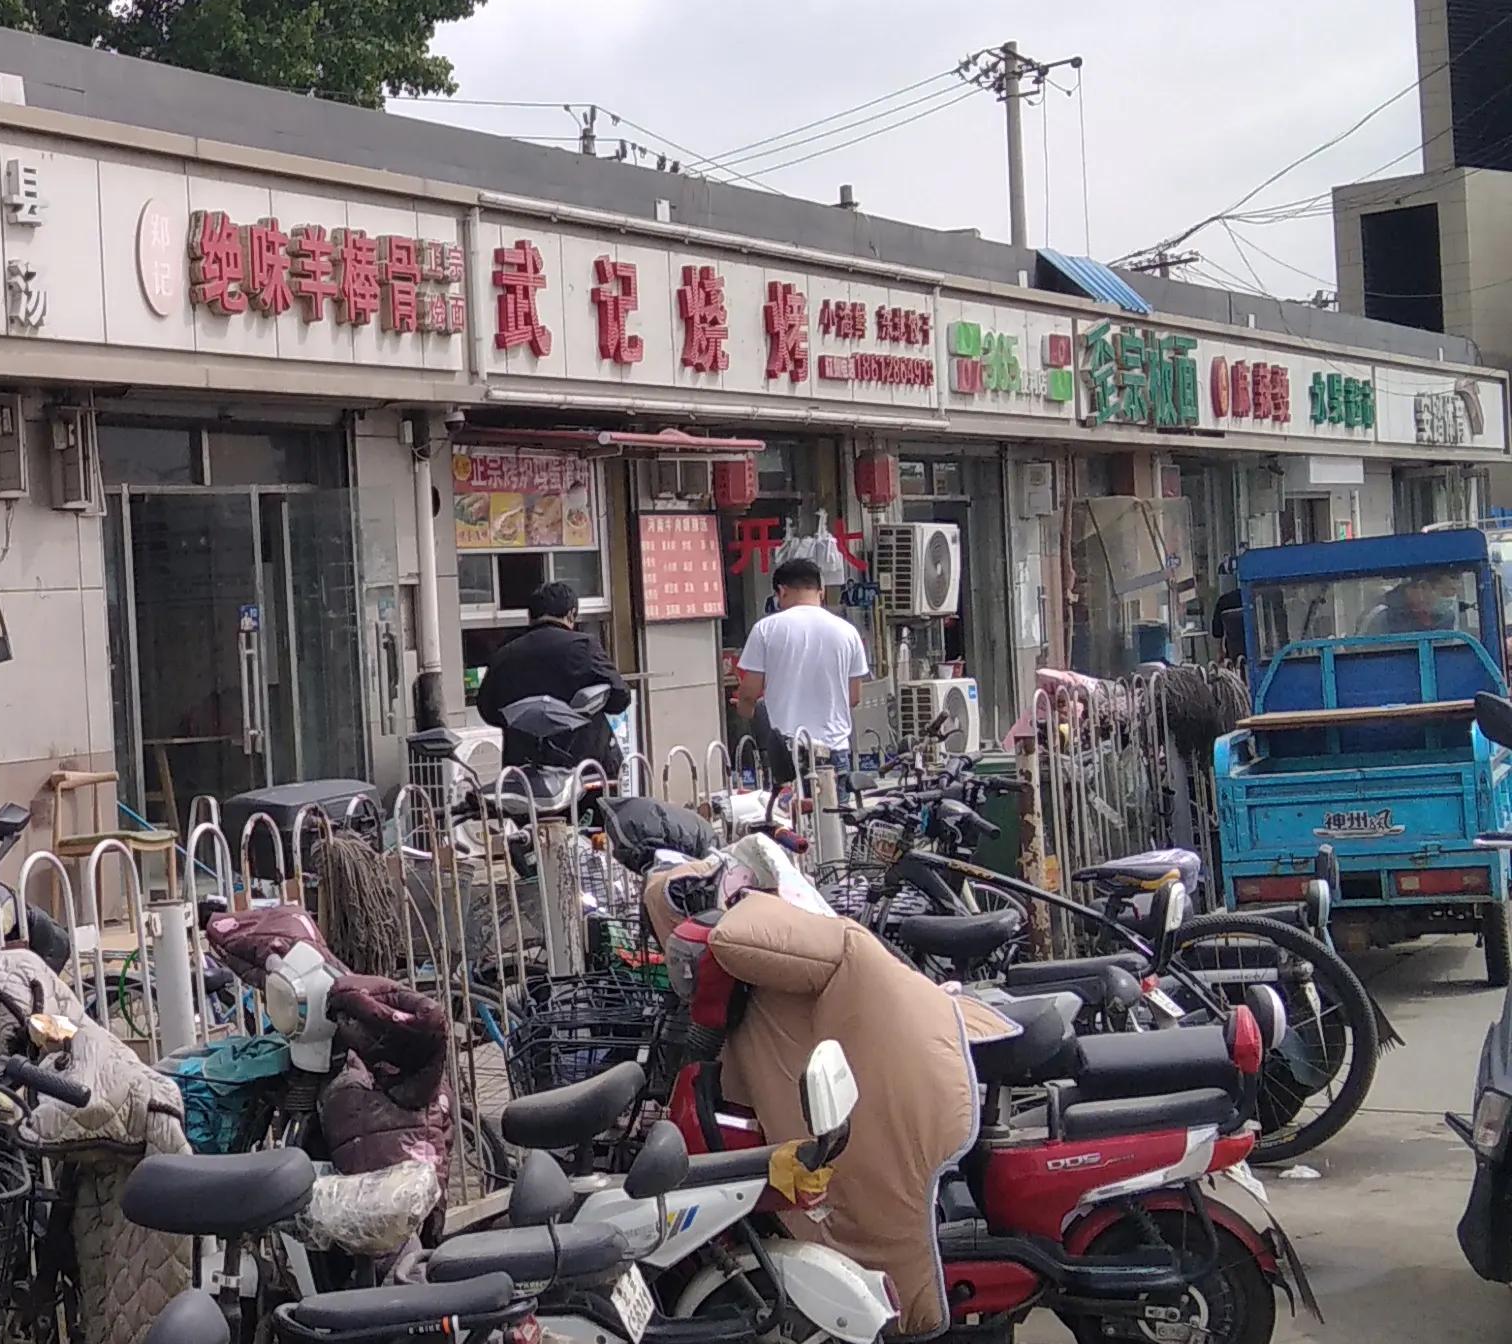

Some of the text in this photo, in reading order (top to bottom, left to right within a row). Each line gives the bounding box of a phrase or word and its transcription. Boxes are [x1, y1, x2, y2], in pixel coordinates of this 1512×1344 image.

[150, 212, 173, 297] 郑记
[190, 210, 421, 333] 绝味羊棒骨
[493, 239, 809, 383] 武记烧烤
